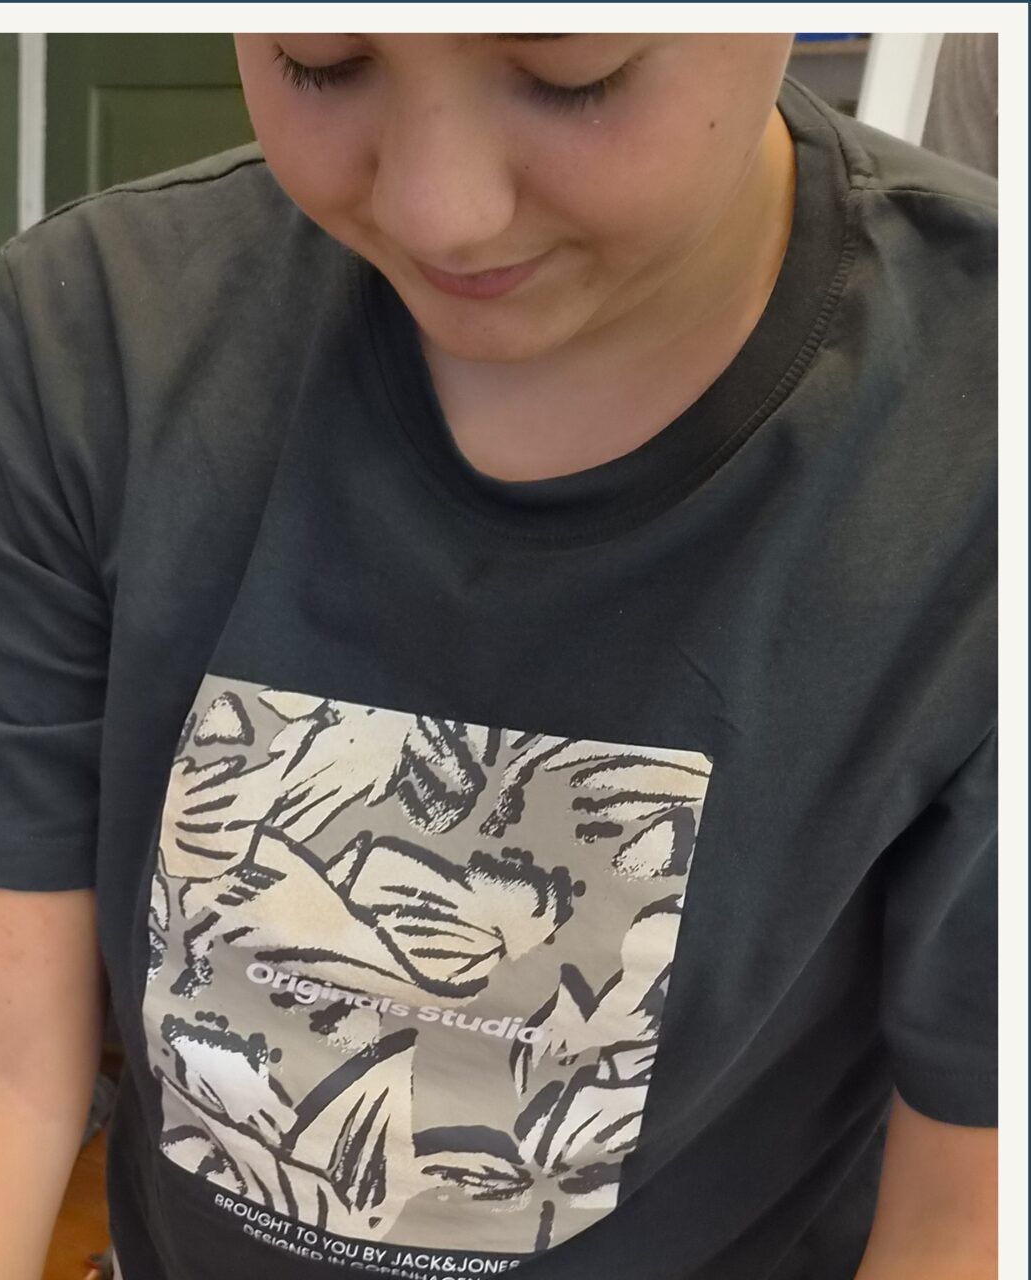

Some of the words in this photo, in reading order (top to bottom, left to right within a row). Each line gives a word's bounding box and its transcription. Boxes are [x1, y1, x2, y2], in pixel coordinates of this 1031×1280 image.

[246, 962, 409, 1018] Originals
[417, 1004, 545, 1044] Studio
[214, 1193, 293, 1236] BROUGHT
[296, 1226, 318, 1245] TO
[322, 1236, 360, 1258] YOU
[362, 1246, 387, 1263] BY
